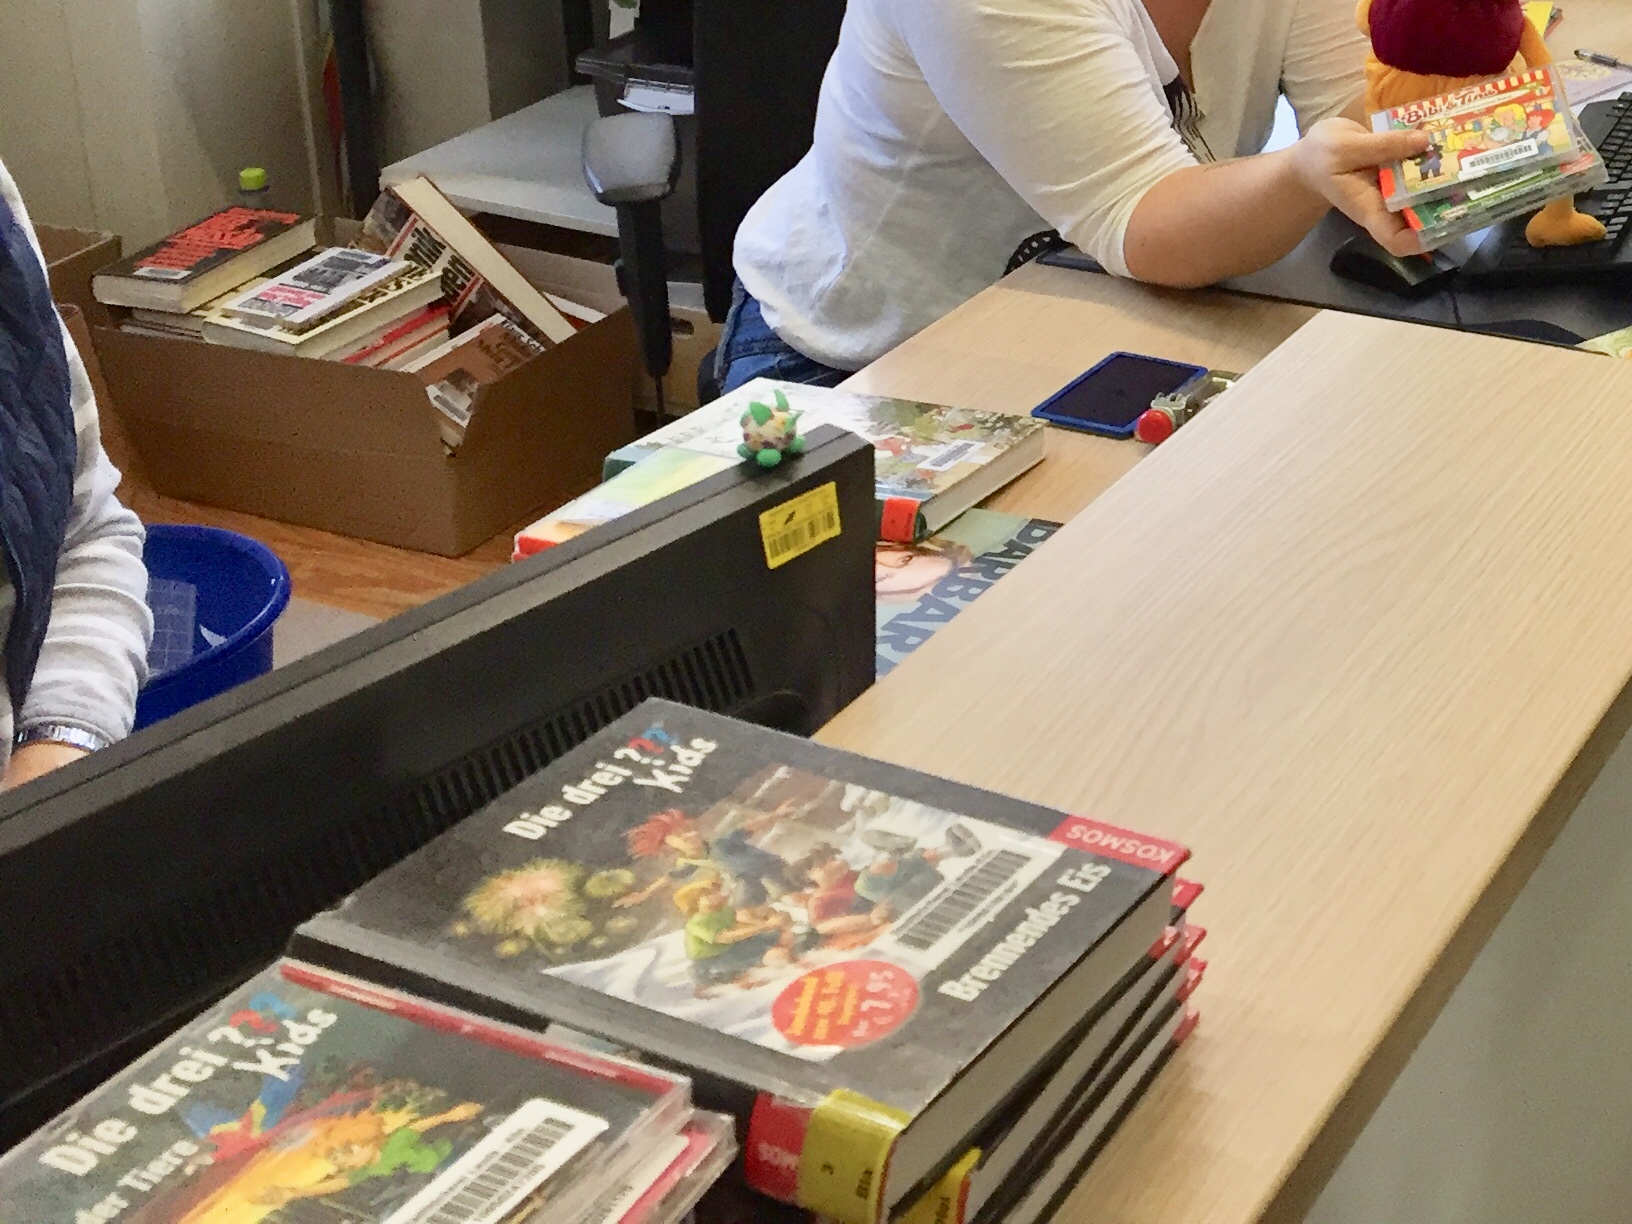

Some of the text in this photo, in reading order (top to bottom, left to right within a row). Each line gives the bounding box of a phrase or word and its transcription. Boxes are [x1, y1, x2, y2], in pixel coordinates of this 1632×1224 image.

[502, 804, 573, 840] Die
[562, 761, 633, 805] drei
[632, 737, 718, 794] Kids
[1066, 824, 1176, 864] KOSMOS
[937, 891, 1081, 1002] Brennendes
[1057, 862, 1112, 893] Eis
[233, 1008, 338, 1082] Kids
[39, 1117, 138, 1176] Die
[128, 1046, 229, 1115] drei
